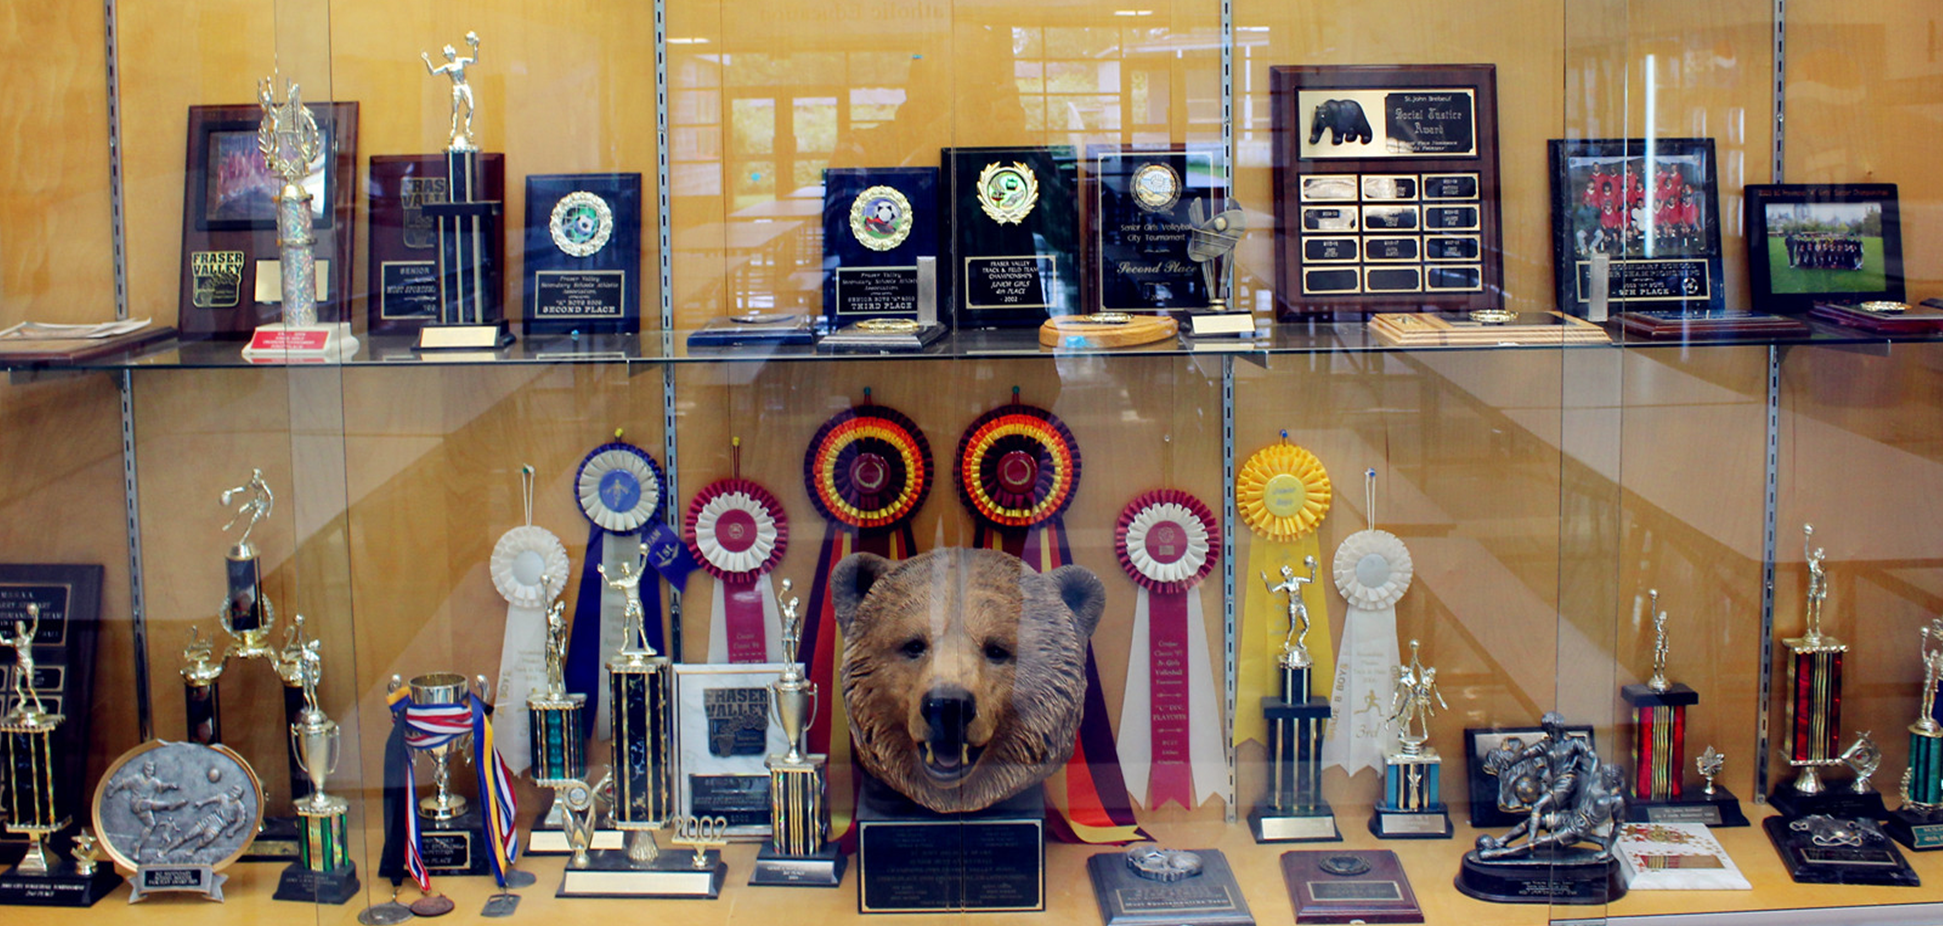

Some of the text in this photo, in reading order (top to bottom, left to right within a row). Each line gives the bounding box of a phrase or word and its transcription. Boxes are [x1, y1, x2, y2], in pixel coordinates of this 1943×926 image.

[1395, 107, 1462, 120] Social Justice
[1414, 122, 1444, 135] Award
[402, 179, 445, 193] FRAS
[402, 195, 445, 207] VALL
[1127, 234, 1141, 243] City
[193, 253, 243, 263] FRASER
[193, 265, 242, 275] VALLEY
[399, 267, 430, 275] SENIOR
[1116, 260, 1197, 274] Second Place
[1609, 262, 1697, 272] ECONDARY SCHOOL
[990, 281, 1012, 289] JUNIOR
[647, 528, 662, 545] EAM
[655, 543, 675, 562] 1st
[1165, 659, 1181, 667] Girls
[1155, 669, 1183, 677] Volleyball
[1335, 663, 1349, 691] BOYS
[705, 689, 768, 703] FRASER
[706, 703, 768, 717] VALLEY
[1153, 713, 1187, 721] PLAYOFFS
[1356, 722, 1381, 739] 3rd
[1147, 899, 1206, 907] Sportsmanlike
